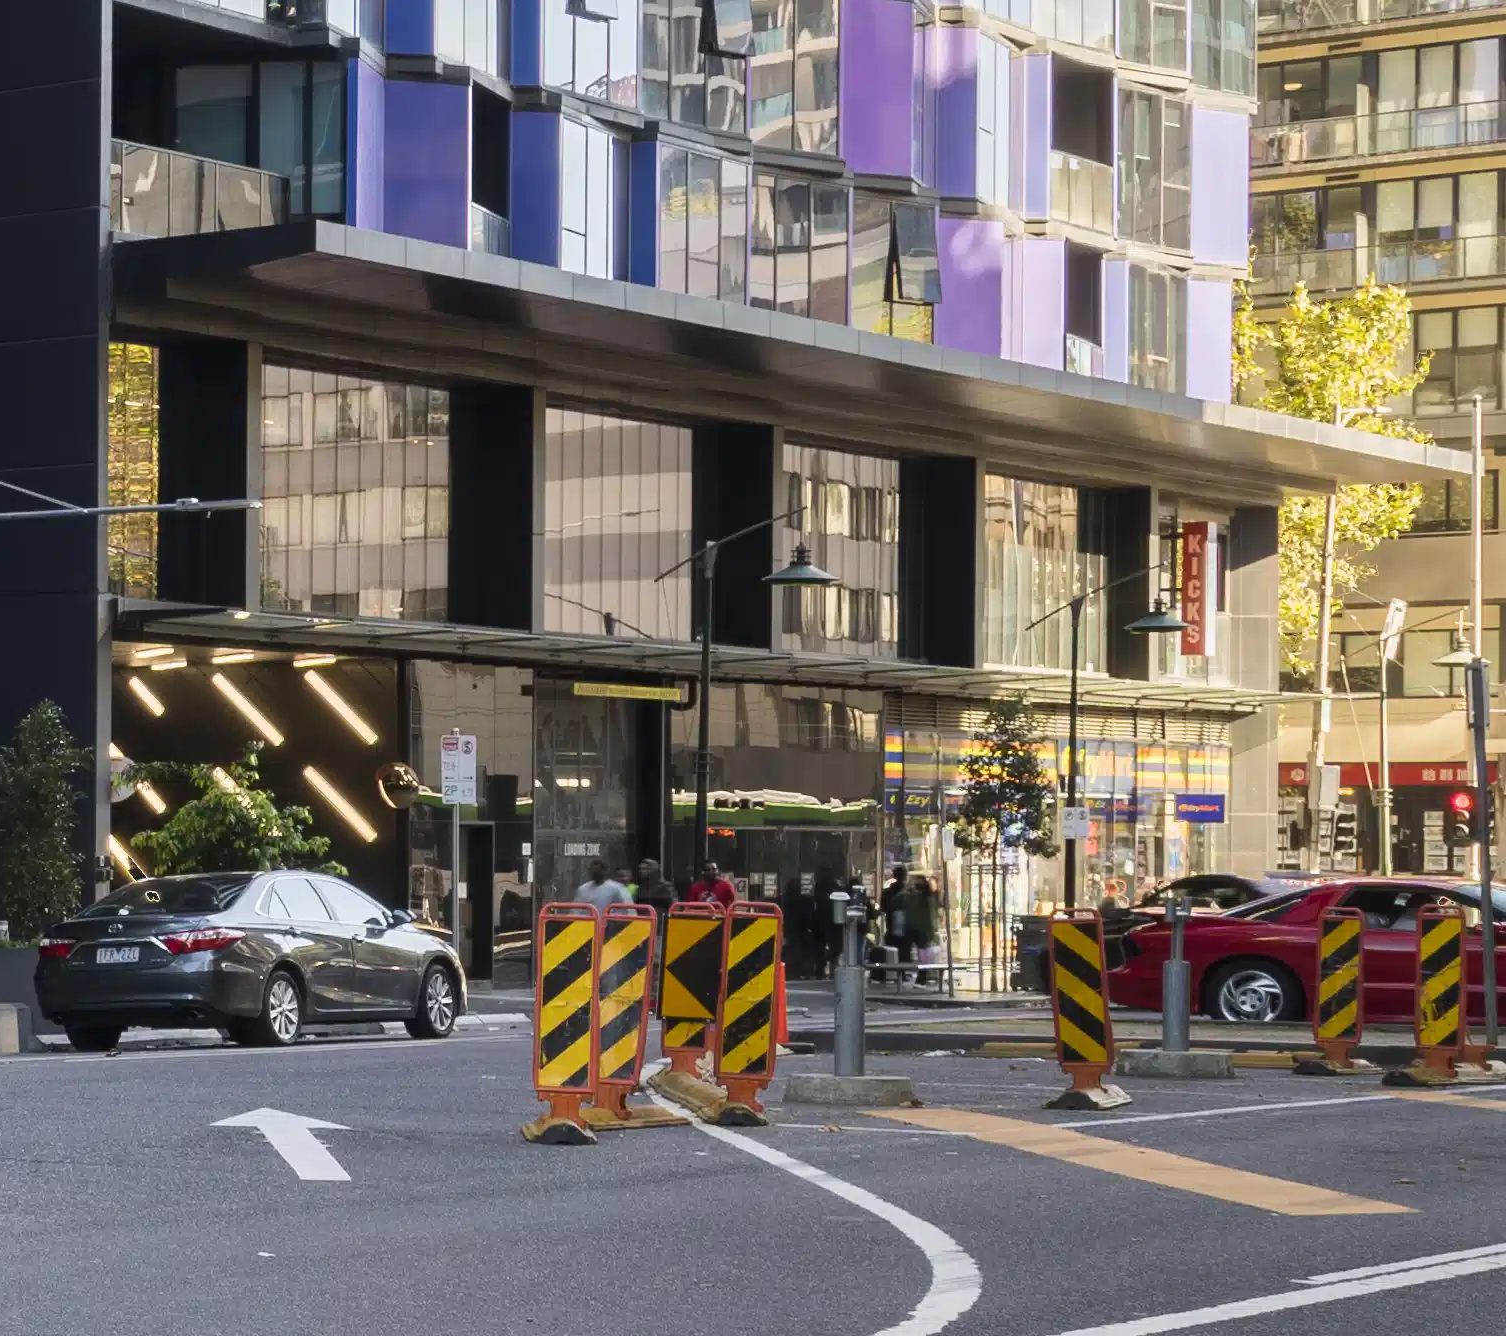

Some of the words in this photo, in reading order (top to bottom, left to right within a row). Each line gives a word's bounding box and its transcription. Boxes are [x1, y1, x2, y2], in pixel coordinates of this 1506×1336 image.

[1186, 533, 1202, 644] KICKS
[564, 843, 586, 856] LOADING
[587, 843, 601, 856] ZONE
